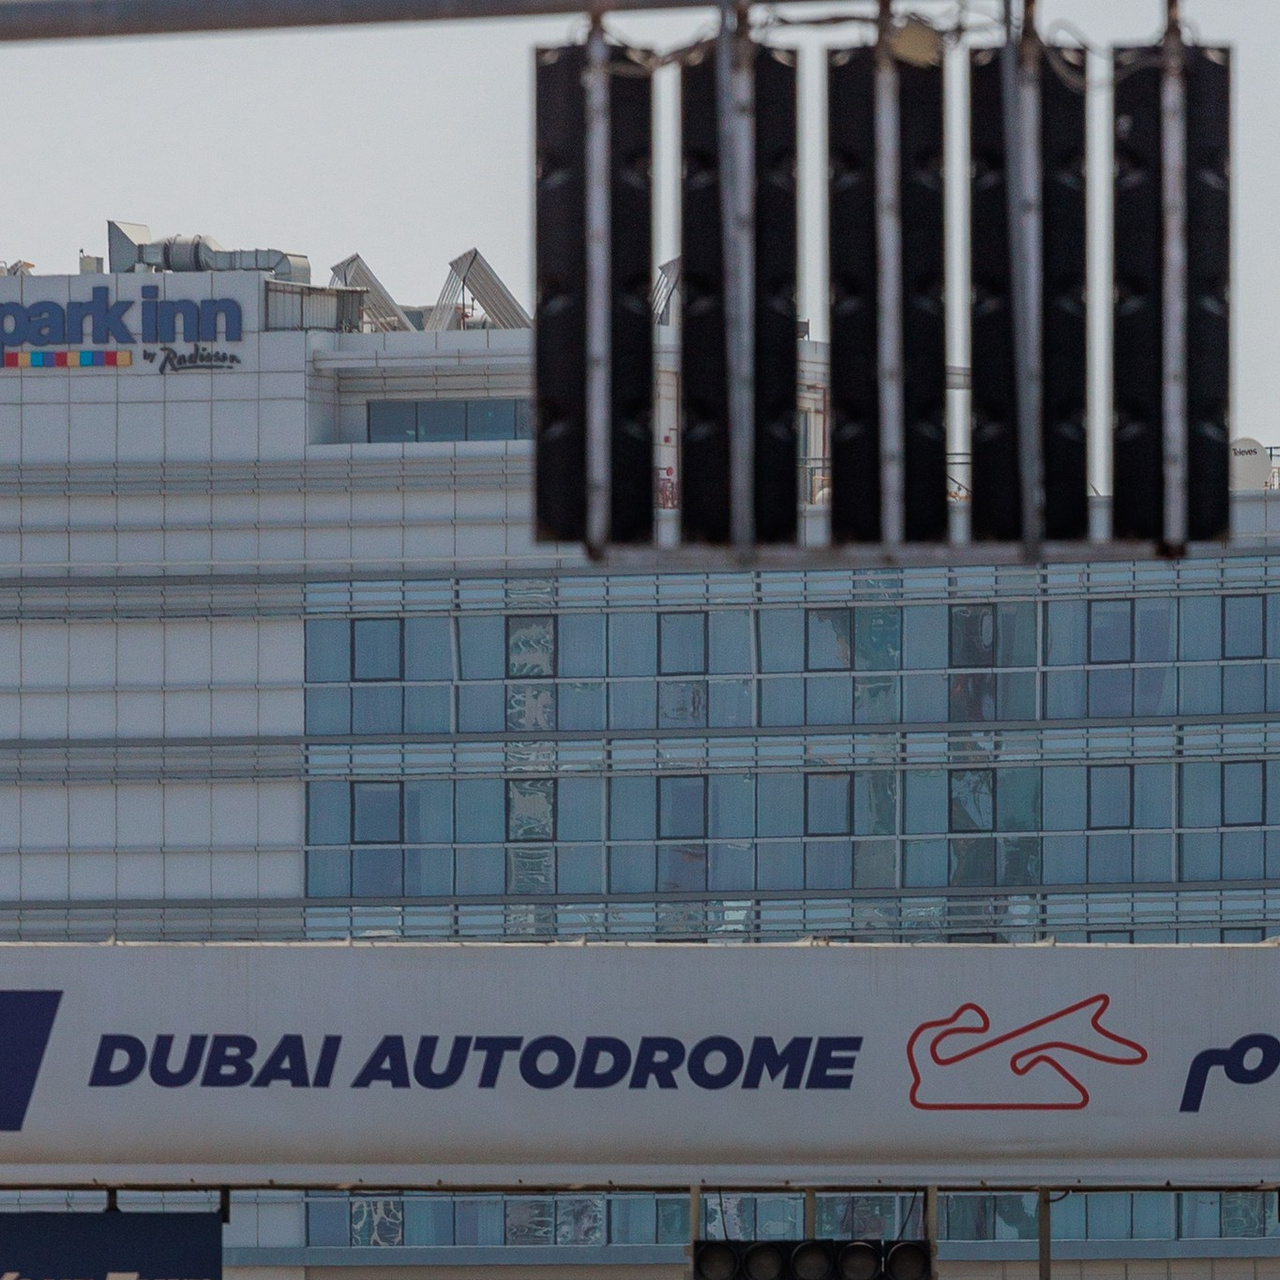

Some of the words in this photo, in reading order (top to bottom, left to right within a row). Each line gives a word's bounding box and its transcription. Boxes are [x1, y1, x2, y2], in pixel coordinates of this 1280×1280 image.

[141, 285, 242, 343] inn
[143, 349, 156, 364] by
[159, 344, 241, 374] Radisson
[1232, 447, 1258, 456] Televes
[88, 1033, 342, 1088] DUBAI
[350, 1035, 863, 1091] AUTODROME
